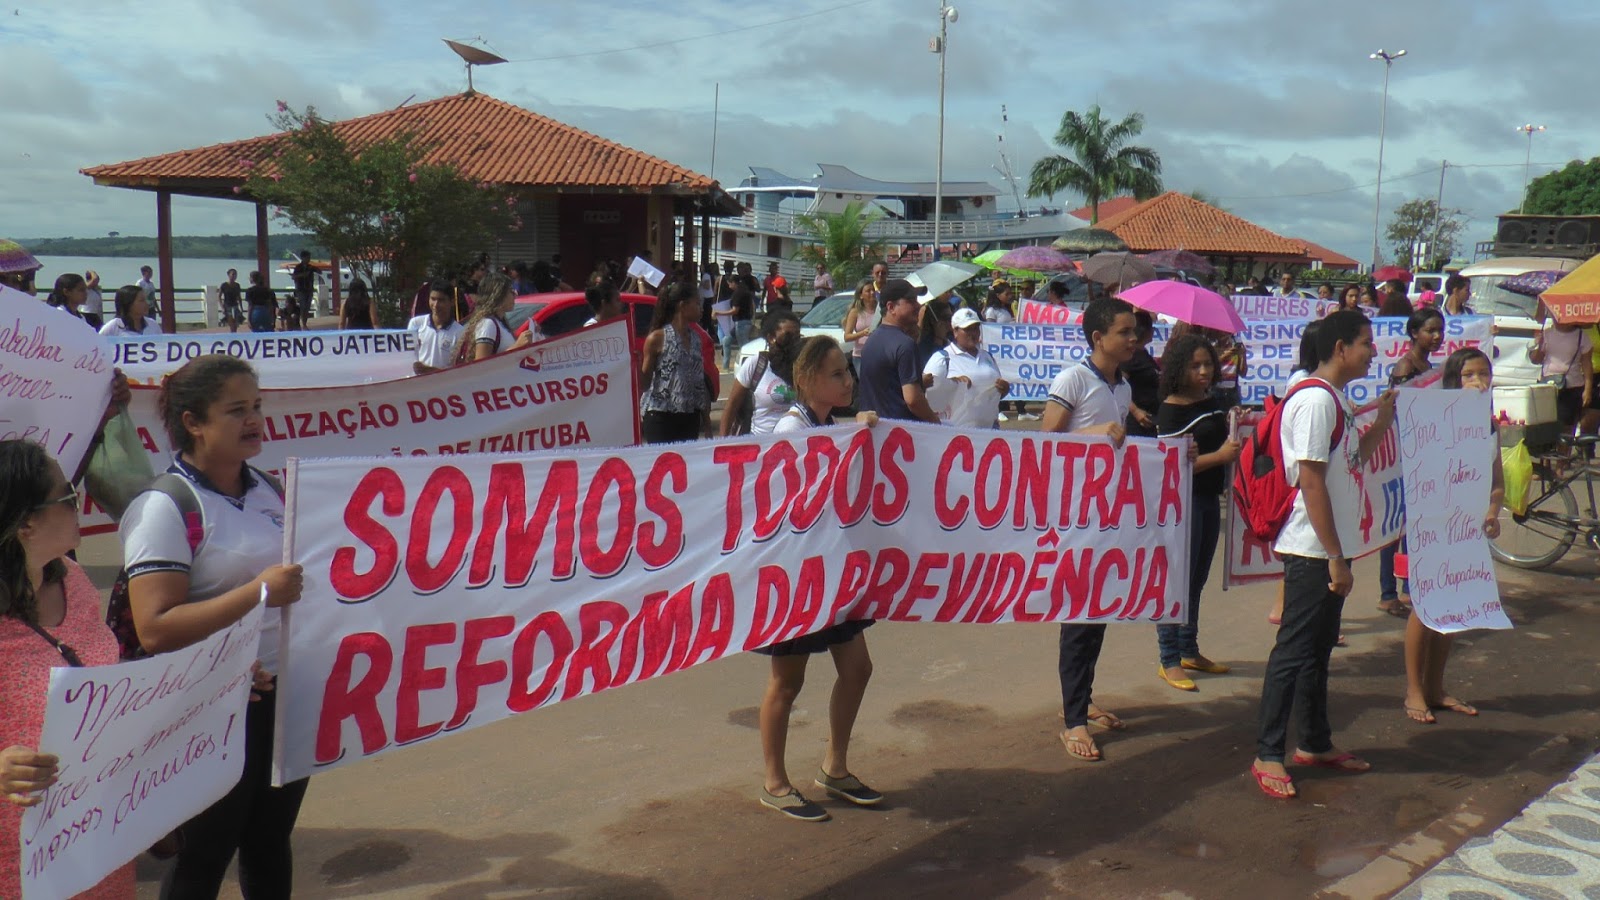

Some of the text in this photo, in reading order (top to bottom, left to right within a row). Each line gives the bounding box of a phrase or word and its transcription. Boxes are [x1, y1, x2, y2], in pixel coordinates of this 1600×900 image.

[1234, 296, 1310, 317] ULHERES
[0, 318, 65, 363] abalhar
[167, 341, 201, 363] DO
[211, 336, 324, 359] GOVERNO
[332, 333, 416, 356] JATENE
[1001, 326, 1056, 341] REDE
[1262, 344, 1292, 359] DE
[1385, 340, 1480, 358] JAENE
[0, 371, 73, 400] orrer...
[1018, 363, 1062, 380] QUE
[263, 401, 399, 442] LIZAÇÃO
[407, 394, 467, 424] DOS
[472, 372, 609, 415] RECURSOS
[479, 421, 591, 453] ITAITUBA
[1401, 396, 1441, 459] Fora
[329, 451, 689, 604] SOMOS
[713, 426, 916, 554] TODOS
[934, 434, 1147, 532] CONTRA
[1408, 514, 1439, 554] Fora
[1409, 556, 1434, 605] Fora
[314, 526, 1182, 766] REFORMA DA PREVIDÊNCIA.
